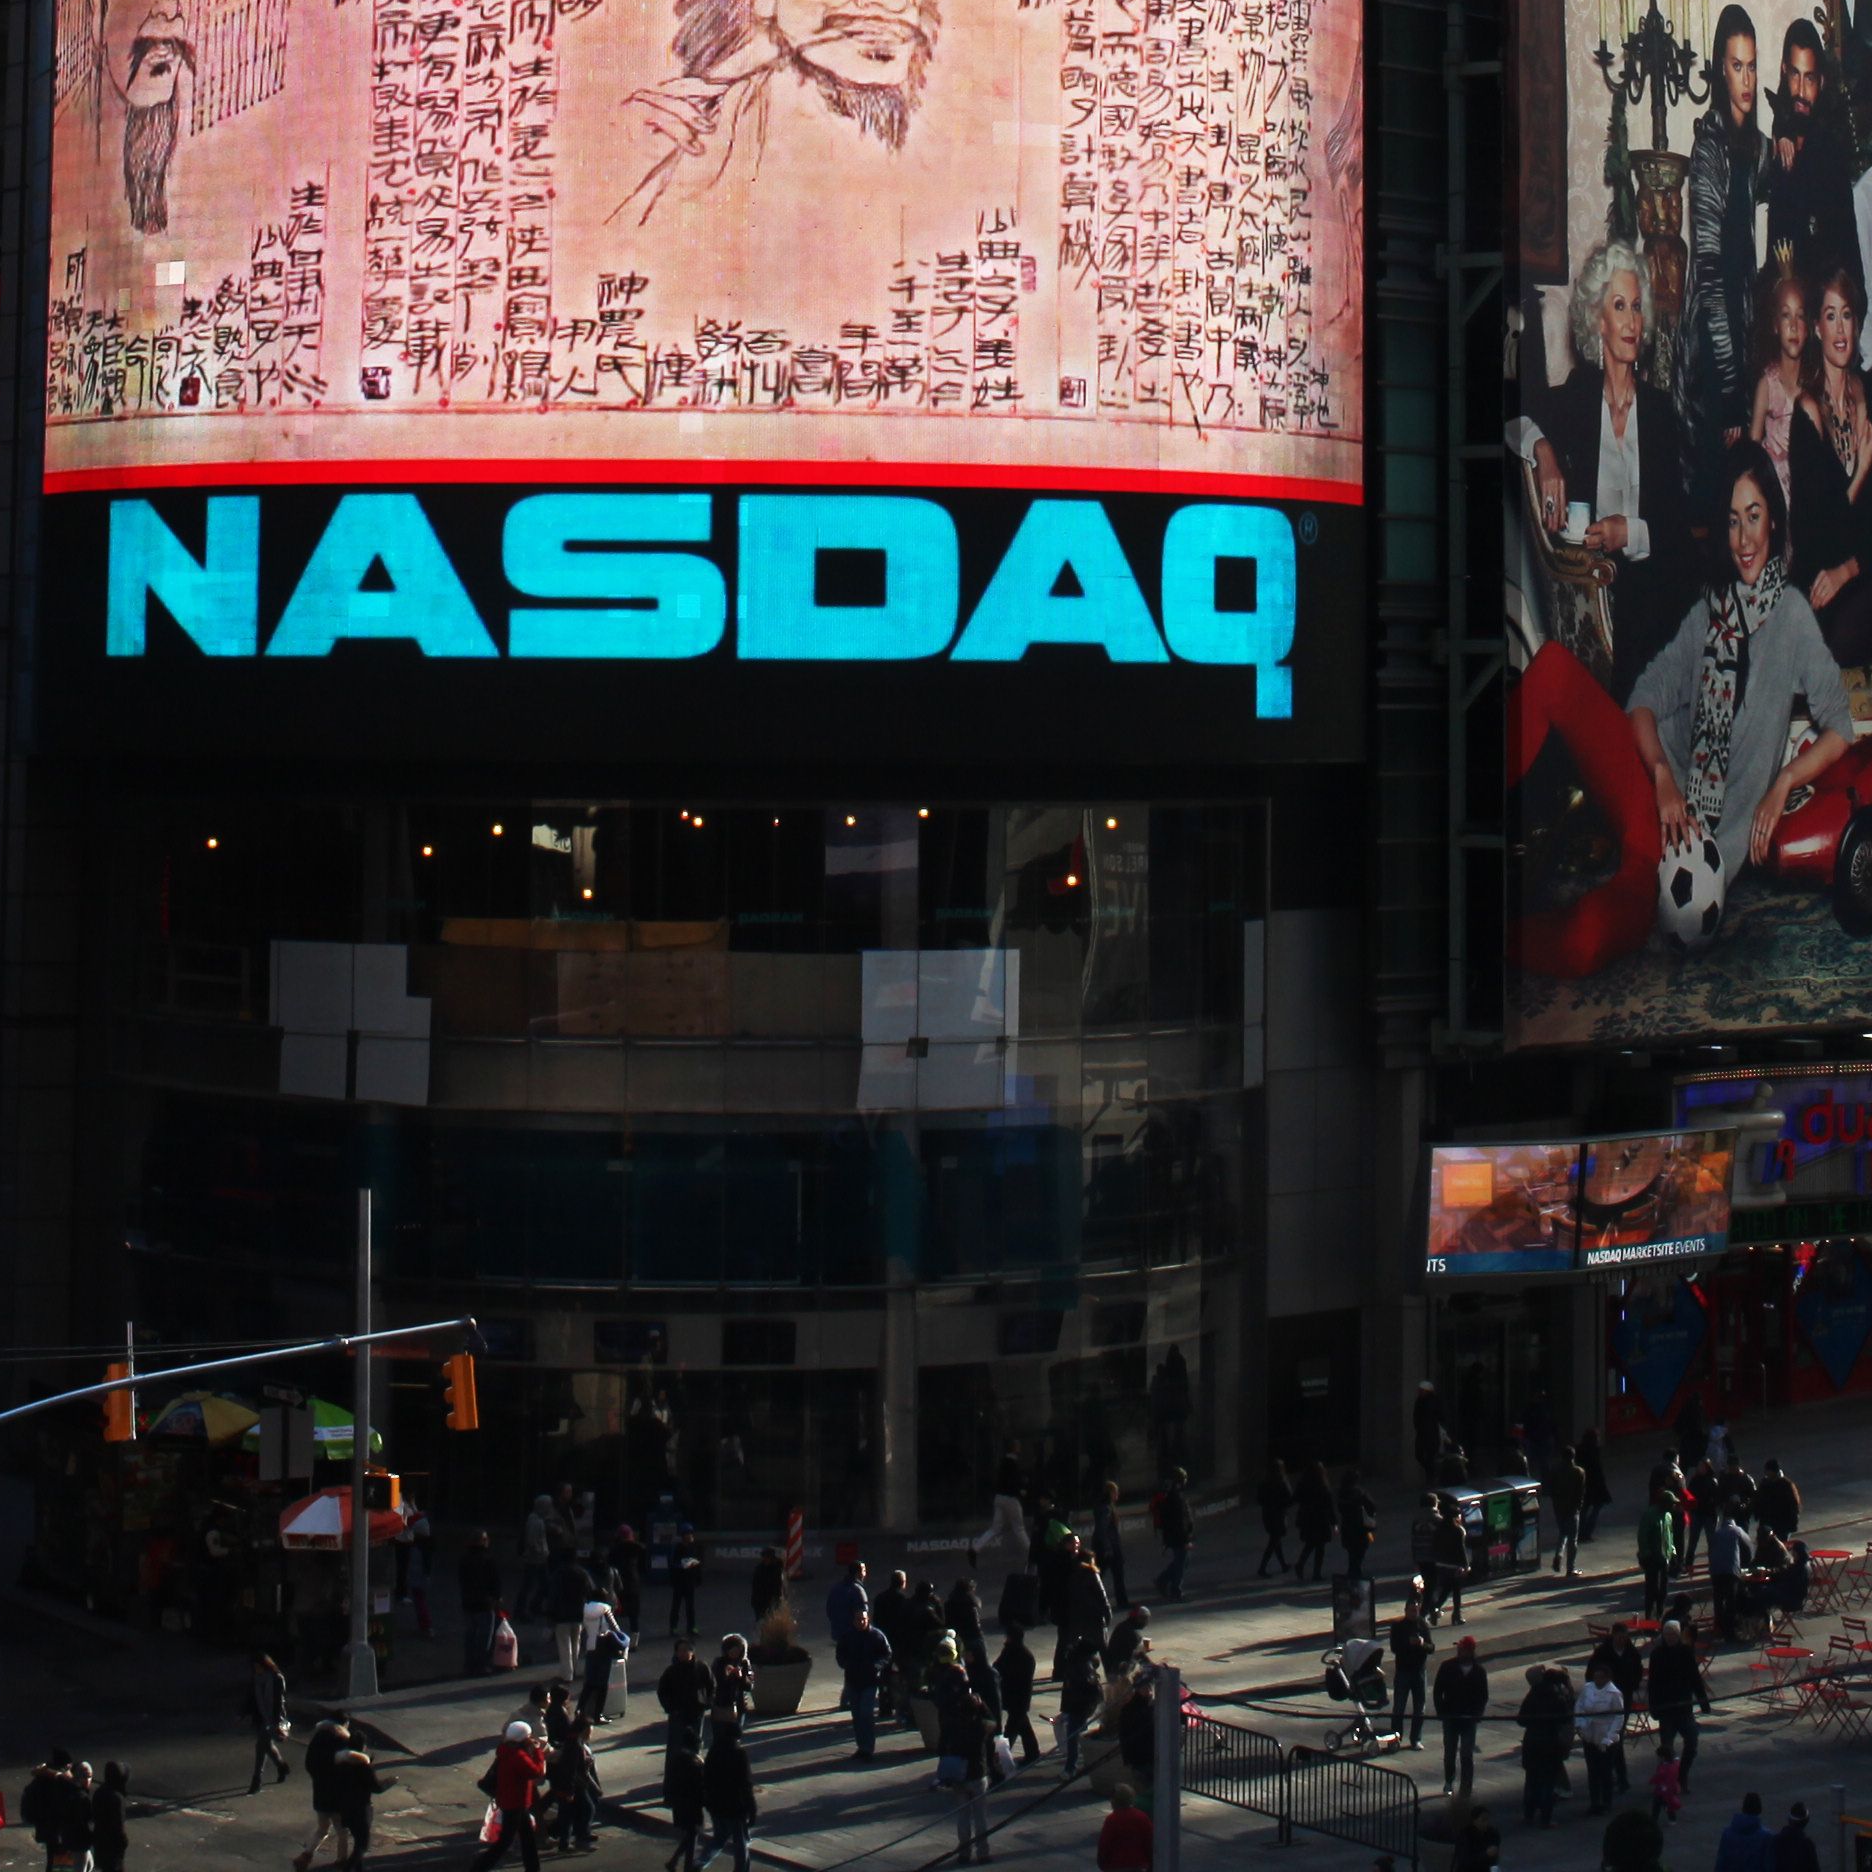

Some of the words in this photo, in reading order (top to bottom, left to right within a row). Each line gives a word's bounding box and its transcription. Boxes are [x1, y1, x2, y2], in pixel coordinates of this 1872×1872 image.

[106, 493, 1297, 719] NASDAQ
[1586, 1249, 1622, 1266] NASDAQ
[1622, 1242, 1675, 1262] MARKETSITE
[1675, 1237, 1706, 1255] EVENTS
[906, 1537, 970, 1553] NASDAQ
